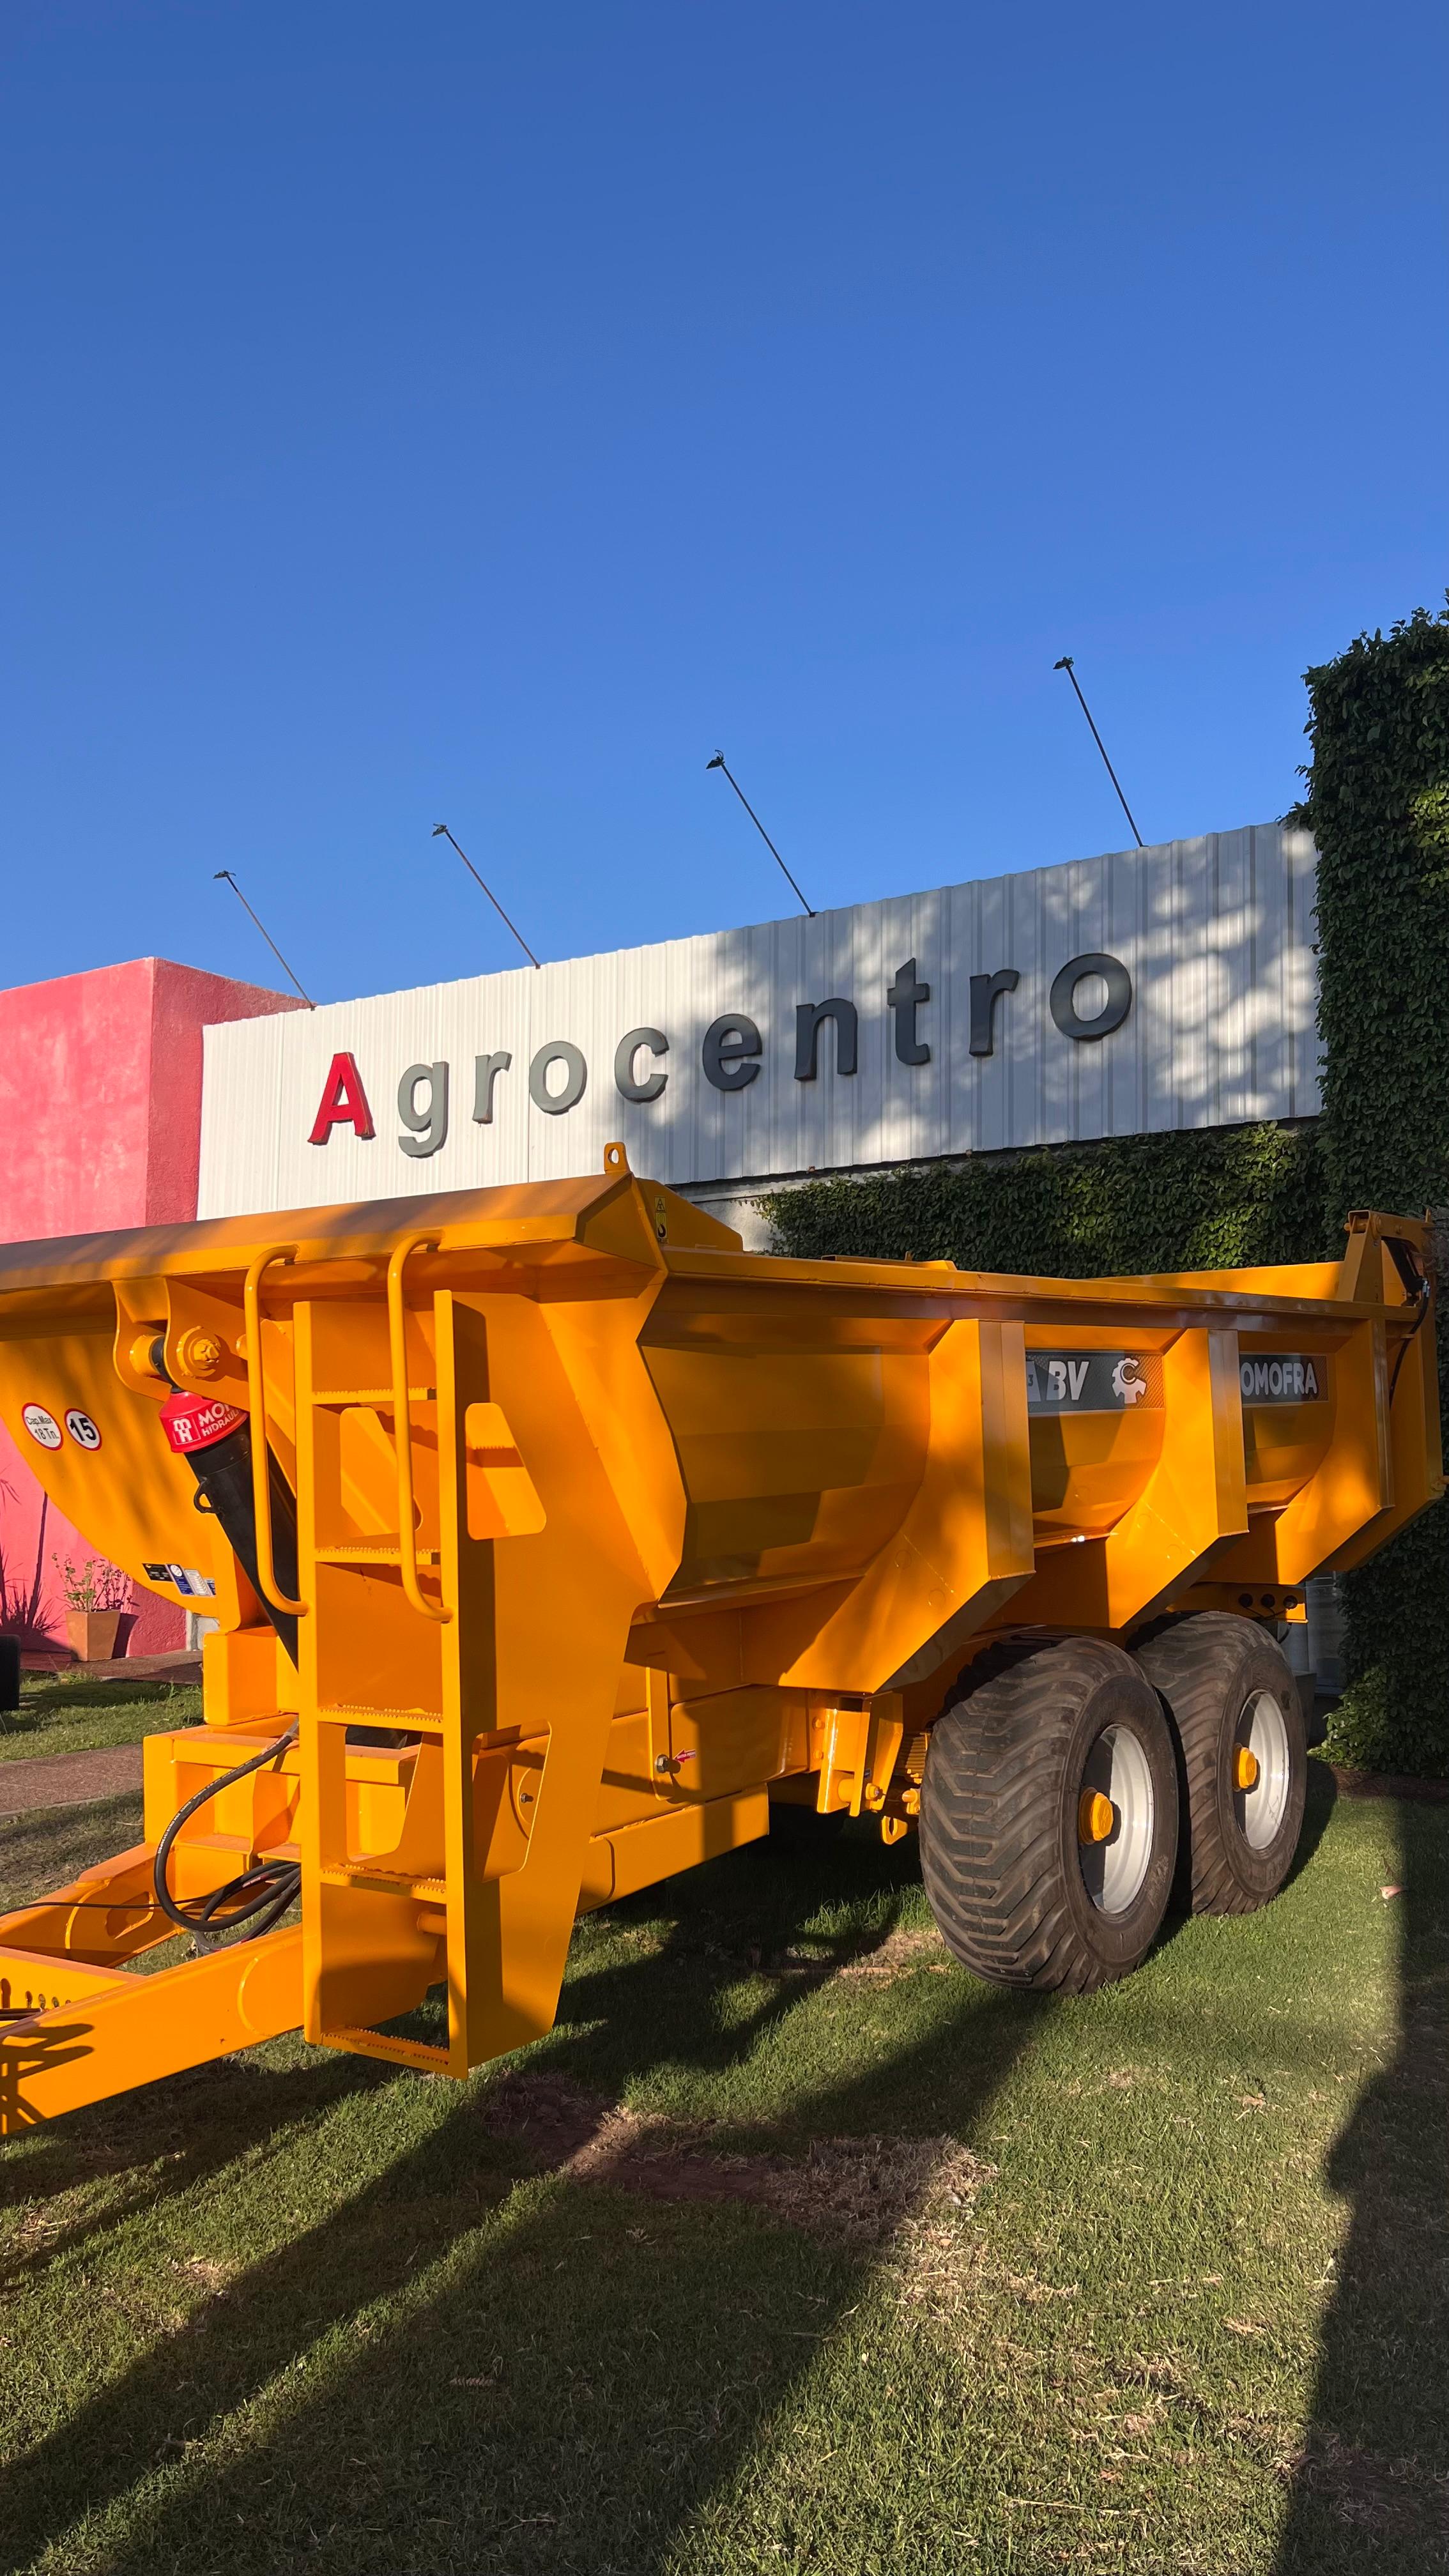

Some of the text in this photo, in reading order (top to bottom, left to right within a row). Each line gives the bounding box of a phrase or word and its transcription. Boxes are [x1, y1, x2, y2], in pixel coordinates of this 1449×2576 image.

[307, 953, 1133, 1158] Agrocentro
[1241, 1362, 1317, 1396] OMOFRA
[34, 1428, 46, 1439] 18
[70, 1418, 96, 1441] 15
